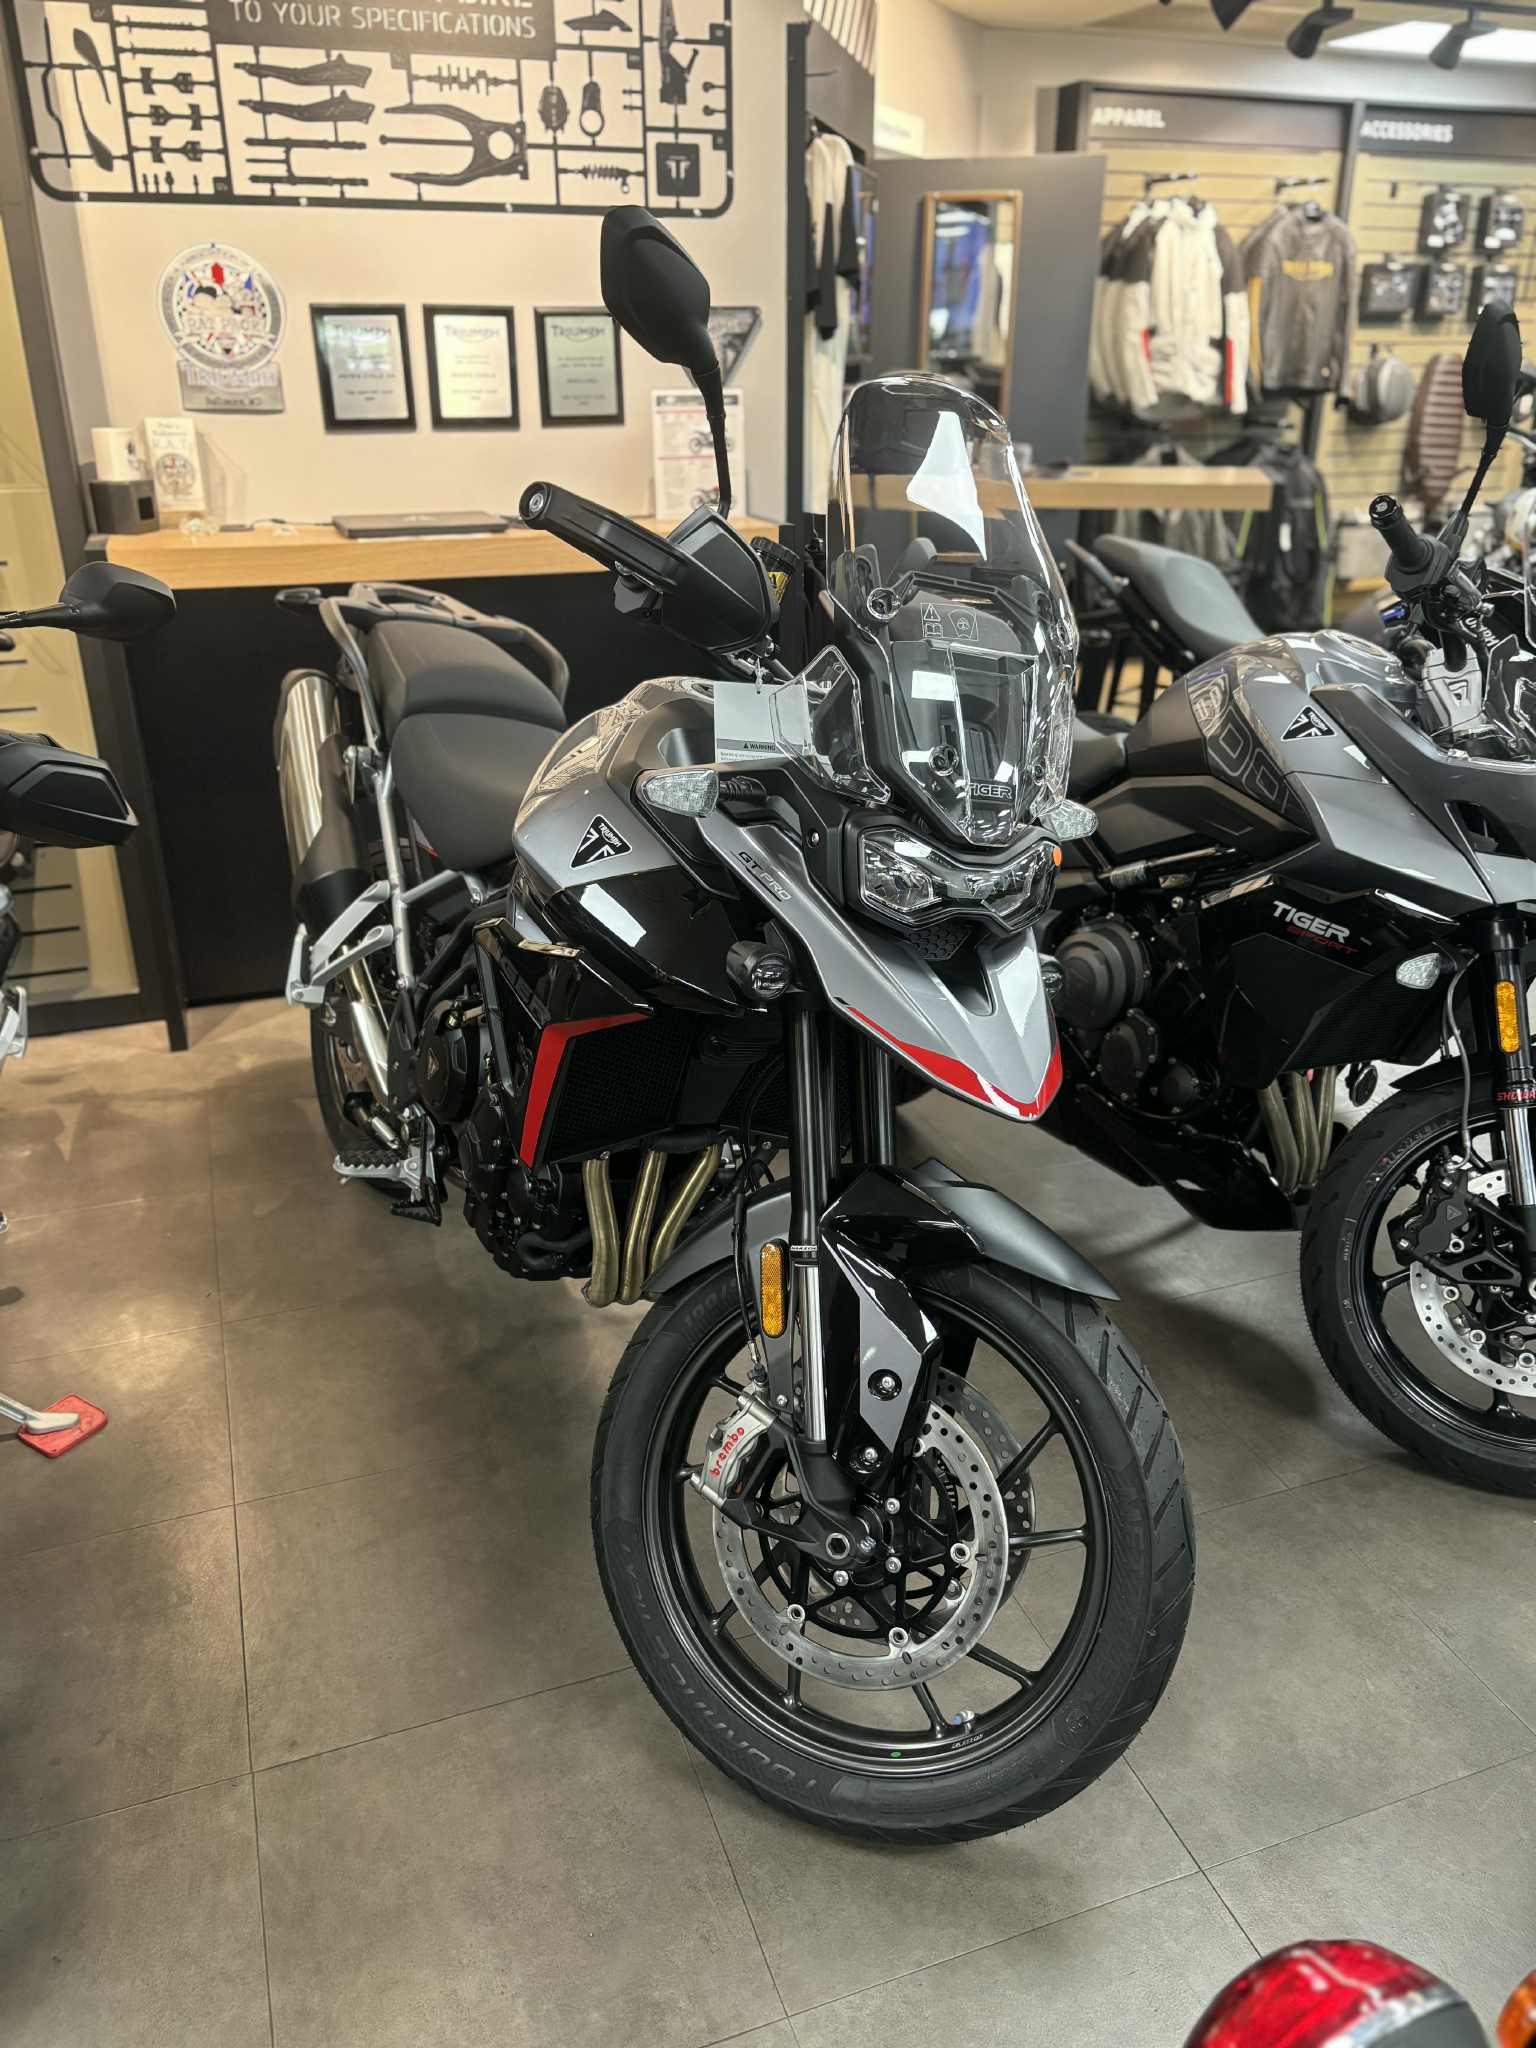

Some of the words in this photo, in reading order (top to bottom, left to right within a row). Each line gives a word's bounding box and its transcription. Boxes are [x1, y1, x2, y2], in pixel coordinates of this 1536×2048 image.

[229, 0, 262, 23] TO
[272, 2, 342, 28] YOUR
[351, 7, 537, 39] SPECIFICATIONS
[1091, 106, 1166, 128] APPAREL
[1360, 119, 1454, 143] ACCESSORIES
[551, 324, 607, 337] TRIUMPH
[749, 742, 776, 752] WARNING
[598, 822, 623, 848] TRIUMPH
[739, 851, 764, 870] GT
[760, 872, 793, 901] PRO
[1273, 900, 1351, 944] TIGER
[1286, 924, 1359, 954] SPORT
[708, 1426, 745, 1477] brembo
